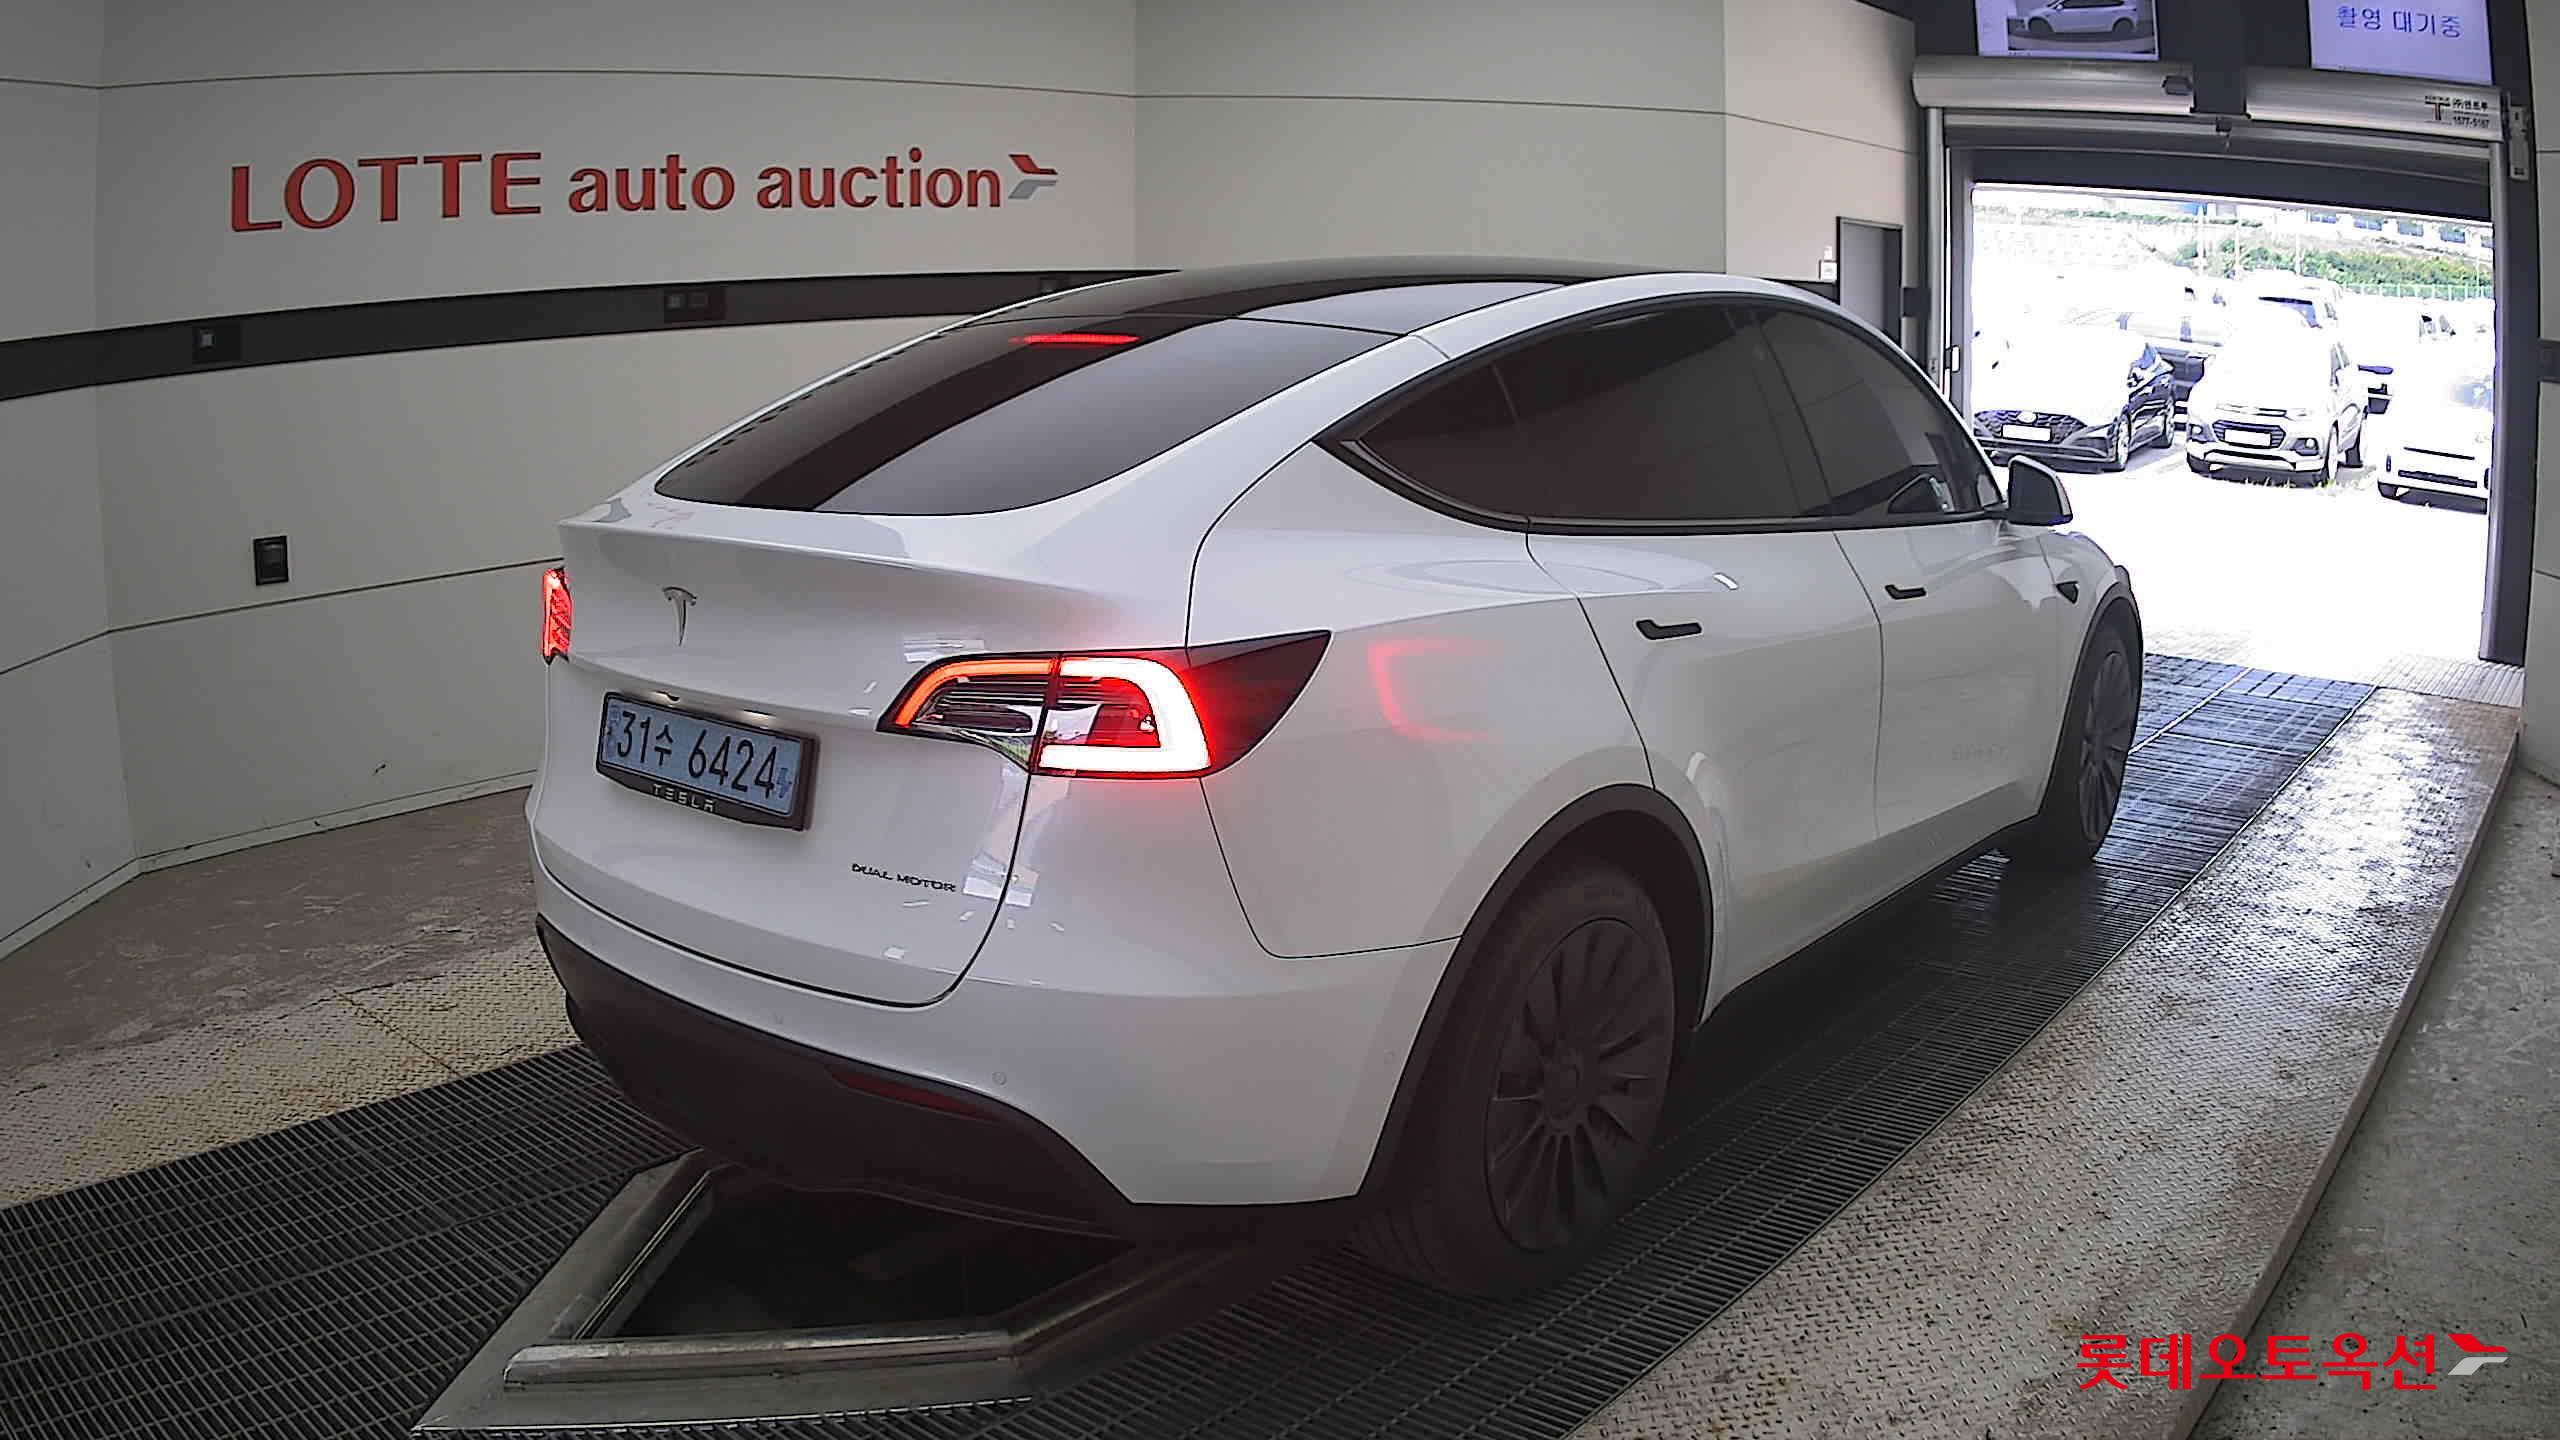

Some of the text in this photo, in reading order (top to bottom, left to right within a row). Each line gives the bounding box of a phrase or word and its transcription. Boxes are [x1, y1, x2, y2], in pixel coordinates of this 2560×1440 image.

[2336, 5, 2462, 38] 촬영 대기중
[230, 147, 1001, 232] LOTTE auto auction
[616, 710, 674, 766] 31수
[687, 729, 777, 798] 6424
[652, 783, 718, 813] TESLA
[851, 863, 957, 893] DUAL MOTOR
